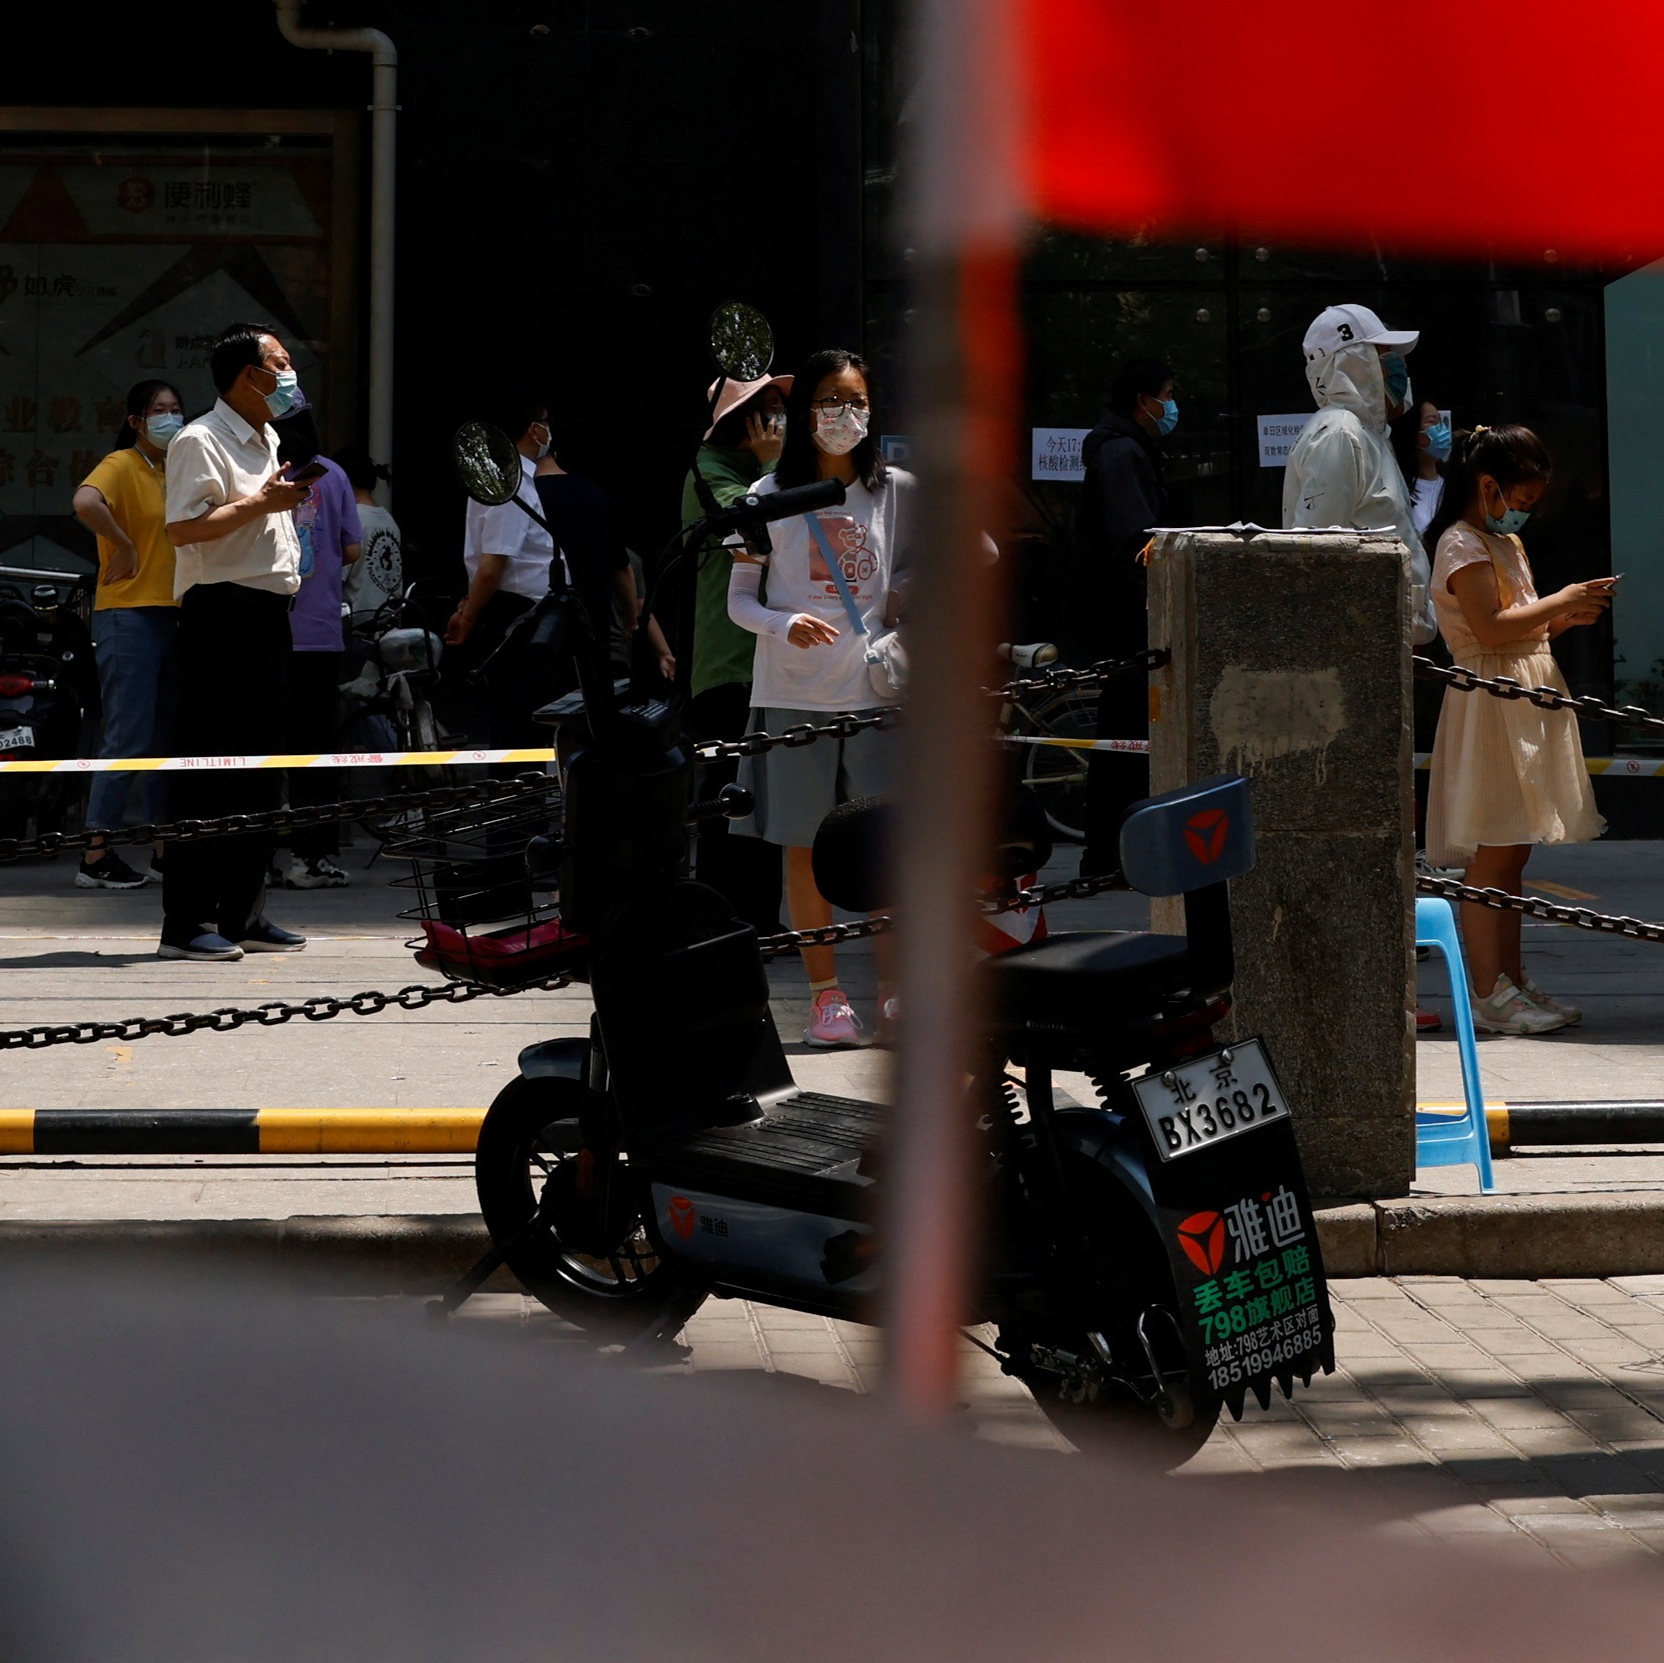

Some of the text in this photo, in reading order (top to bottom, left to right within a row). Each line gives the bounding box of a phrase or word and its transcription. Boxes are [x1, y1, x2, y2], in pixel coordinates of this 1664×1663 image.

[164, 181, 252, 209] 便利蜂
[24, 272, 76, 297] 如虎
[1337, 323, 1355, 342] 3
[179, 756, 247, 768] LIMITLINE
[1171, 1064, 1239, 1105] 北京
[1157, 1082, 1277, 1151] BX3682
[699, 1215, 730, 1239] 雅迪
[1224, 1184, 1306, 1264] 雅迪
[1192, 1244, 1311, 1315] 丢车包赔
[1198, 1276, 1317, 1346] 798旗舰店
[1204, 1303, 1320, 1369] 地址:798艺术区对面
[1207, 1324, 1323, 1391] 18519946885
